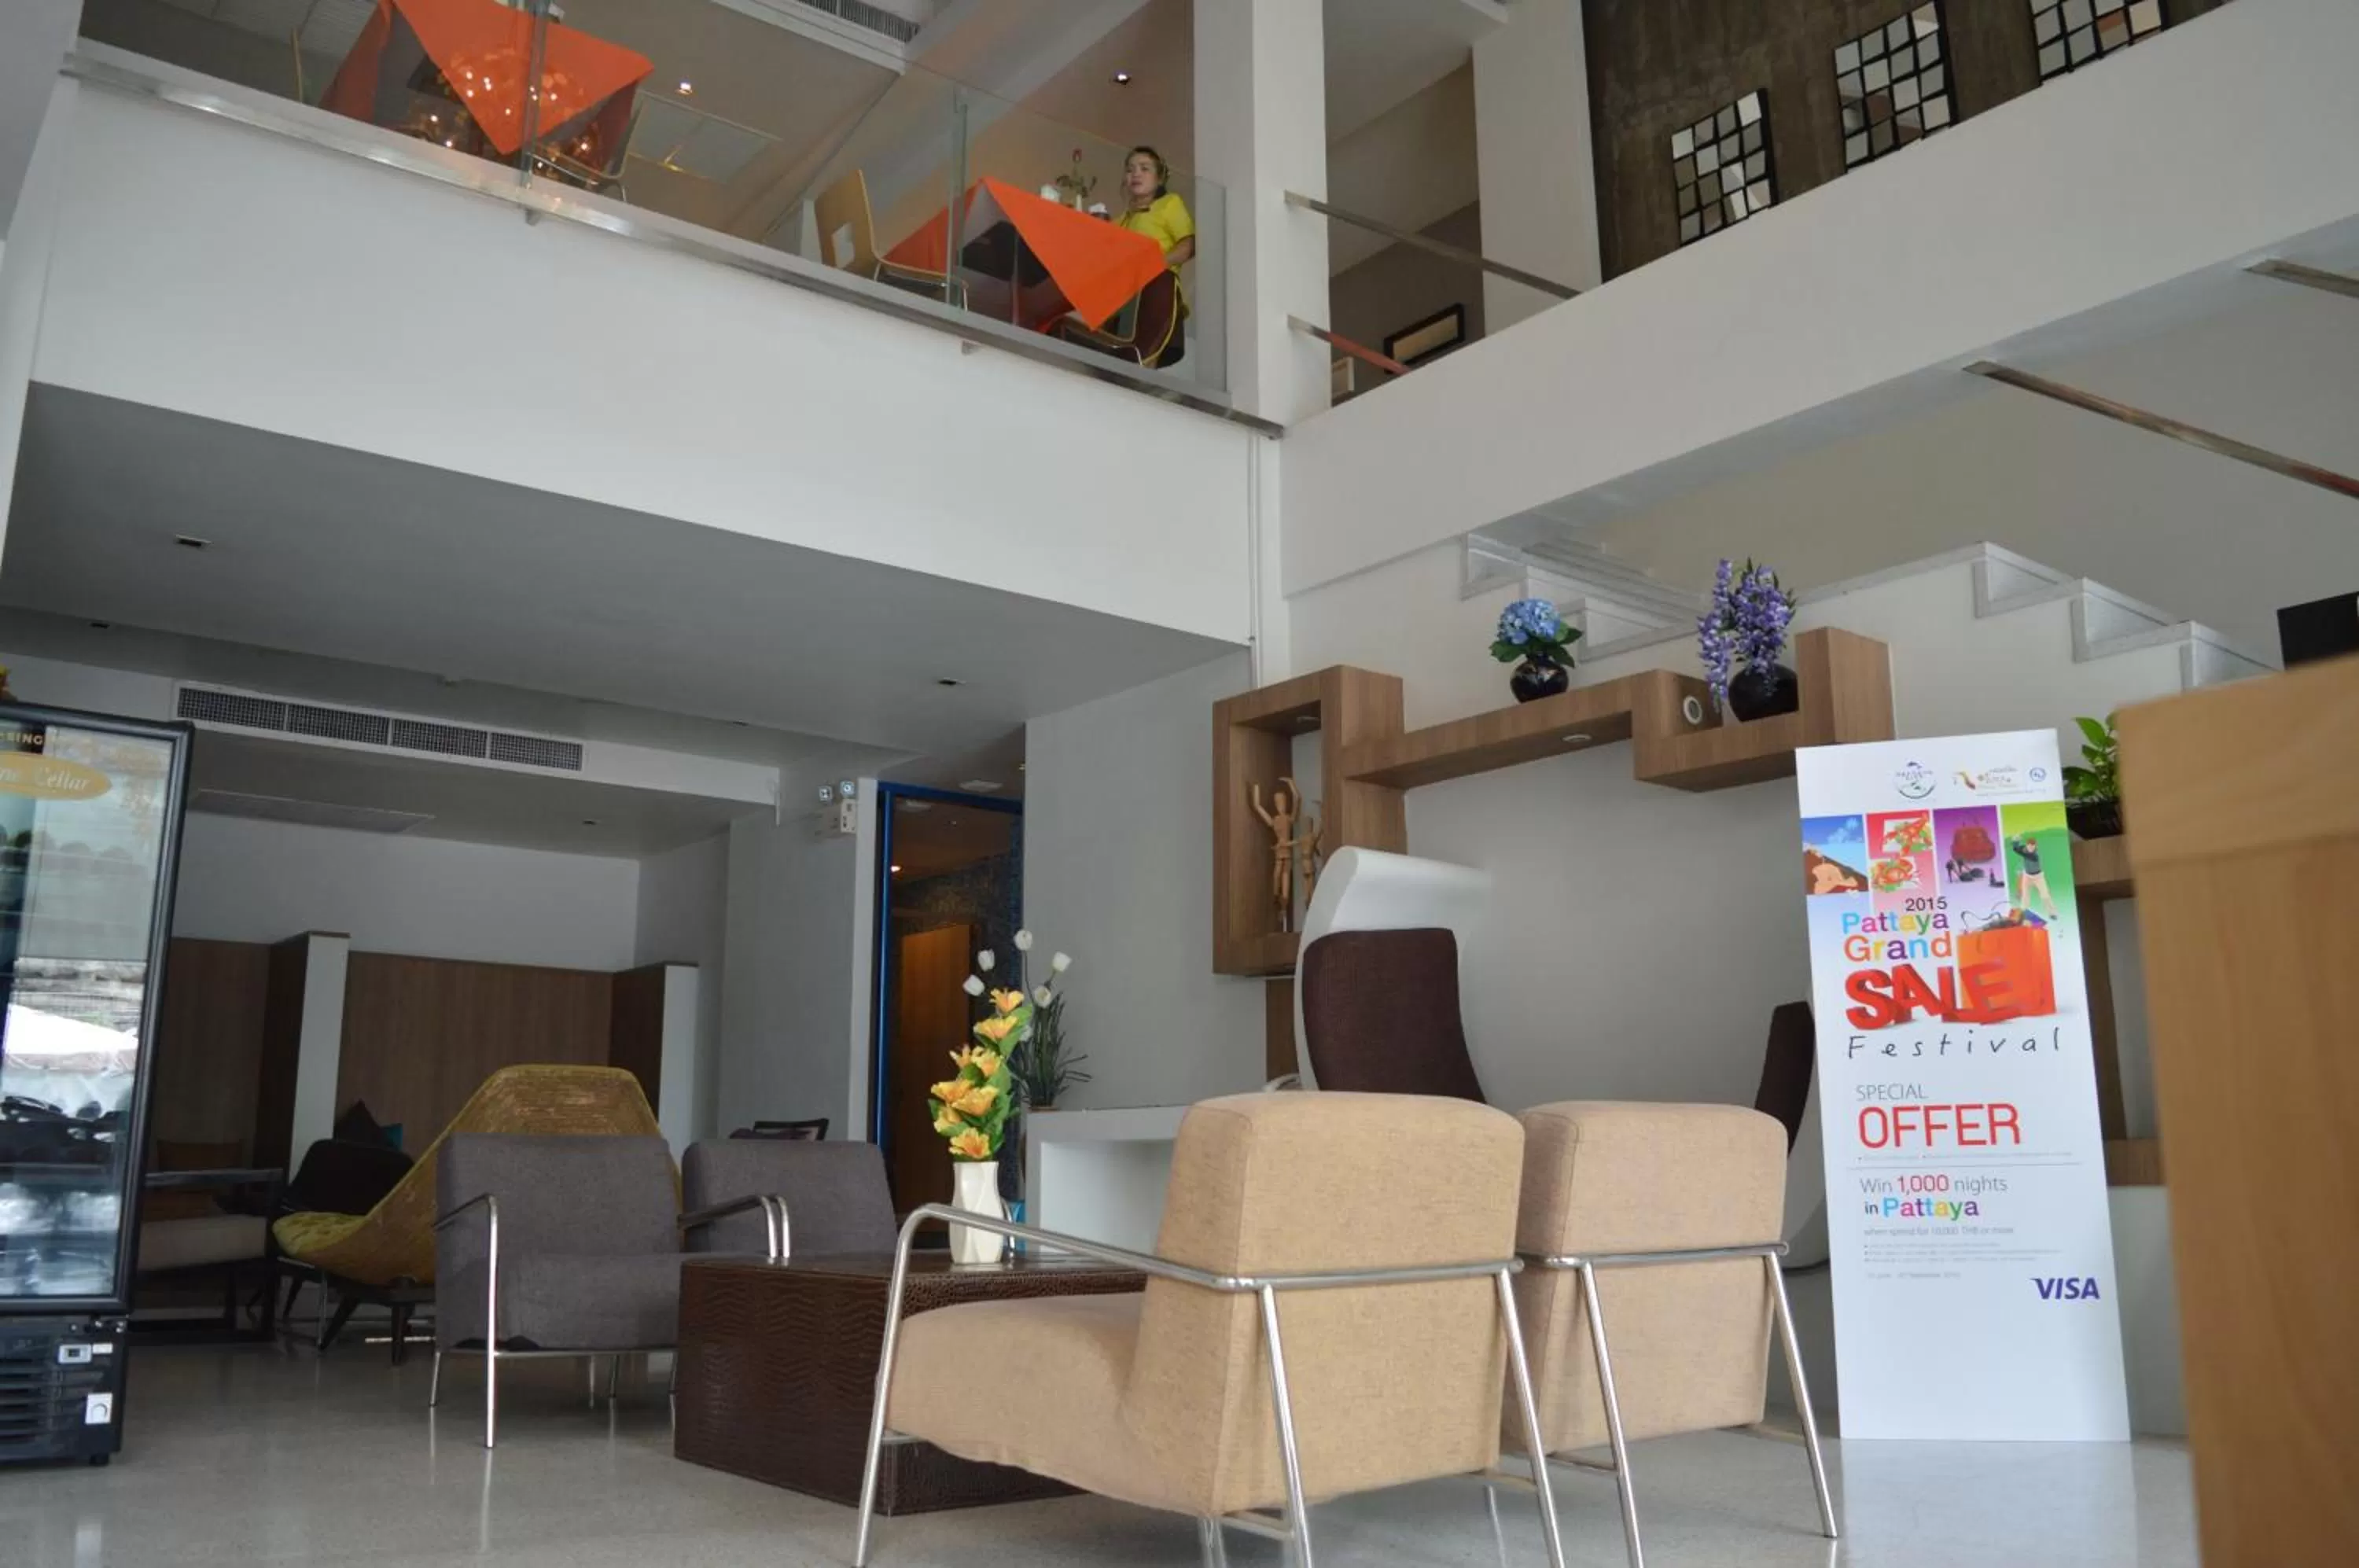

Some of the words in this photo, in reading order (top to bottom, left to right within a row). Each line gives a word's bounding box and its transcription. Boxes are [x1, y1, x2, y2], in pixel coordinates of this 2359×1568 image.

[1905, 897, 1948, 912] 2015
[1842, 911, 1949, 935] Pattaya
[1844, 931, 1952, 962] Grand
[1846, 963, 2022, 1030] SALE
[1848, 1027, 2060, 1058] Festival
[1856, 1084, 1928, 1102] SPECIAL
[1858, 1102, 2021, 1148] OFFER
[1860, 1178, 1893, 1194] Win
[1897, 1174, 1949, 1196] 1,000
[1954, 1176, 2008, 1196] nights
[1864, 1202, 1879, 1215] in
[1882, 1197, 1979, 1220] Pattaya
[2031, 1277, 2100, 1300] VISA
